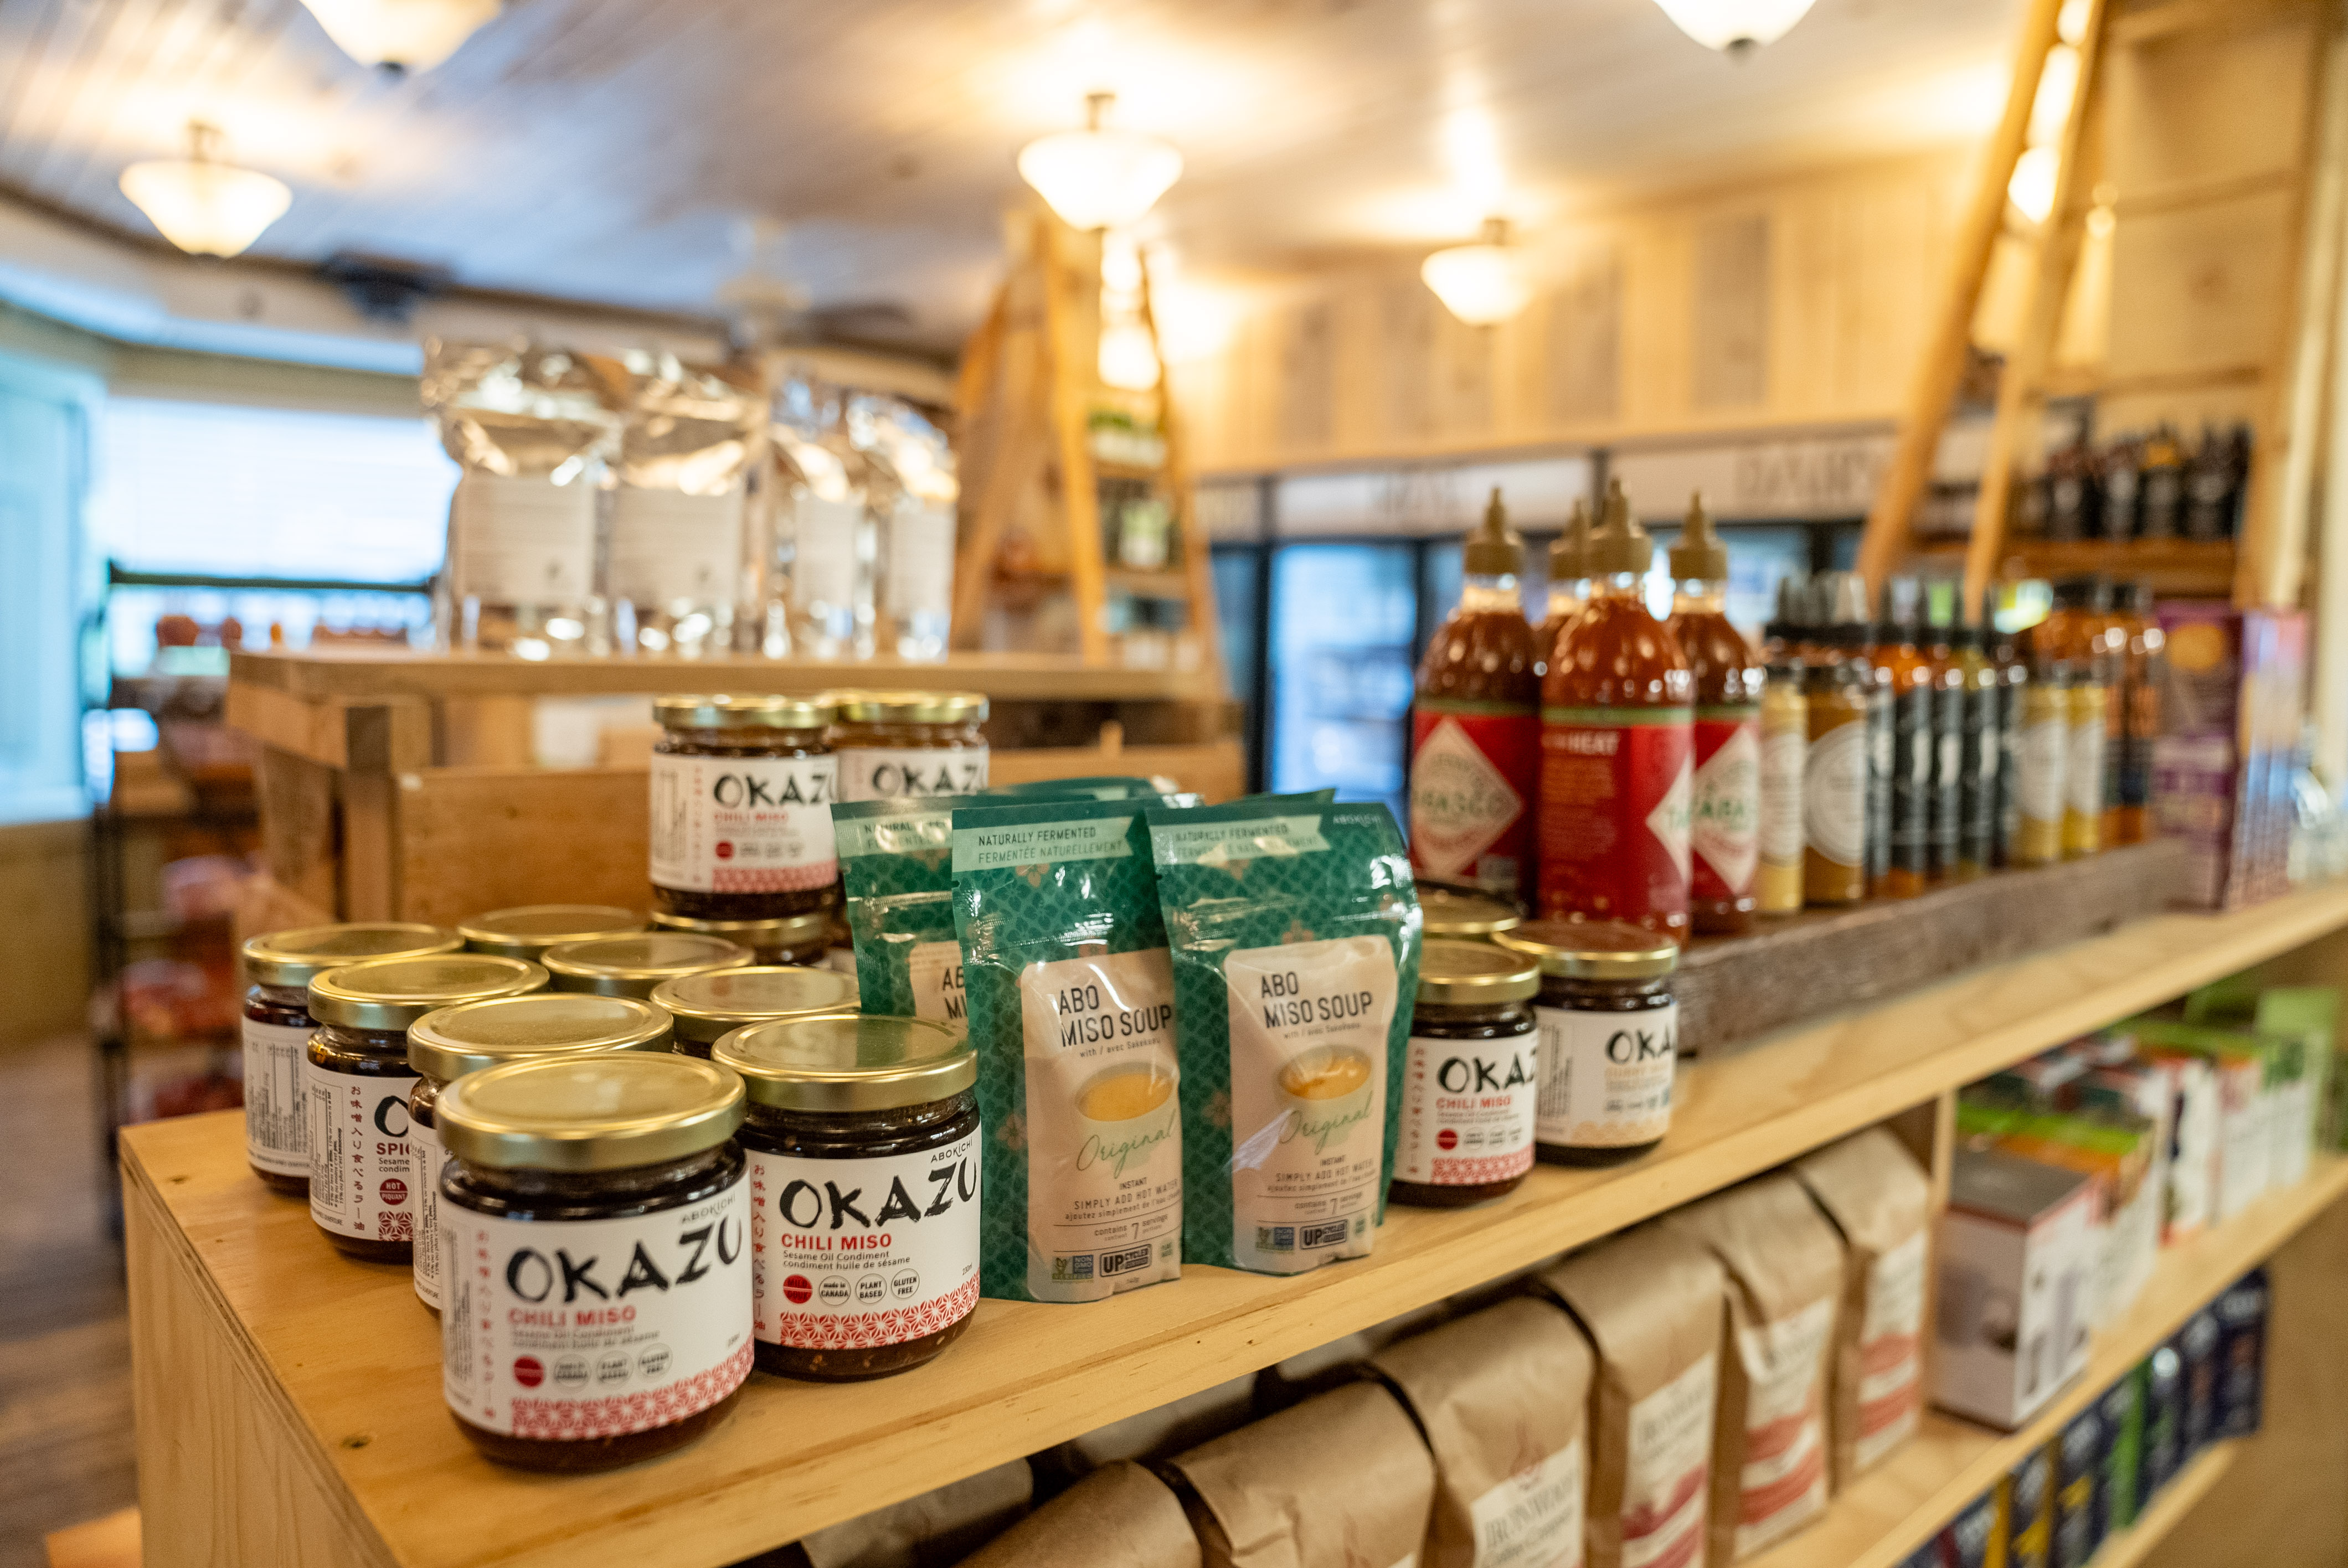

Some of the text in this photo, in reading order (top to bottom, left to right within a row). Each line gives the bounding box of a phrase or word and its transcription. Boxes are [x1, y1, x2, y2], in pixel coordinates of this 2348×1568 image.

[979, 826, 1096, 846] NATURALLY FERMENTED
[979, 840, 1121, 863] FERMENTÉE NATURELLEMENT
[1261, 971, 1298, 998] ABO
[1059, 985, 1100, 1015] ABO
[1263, 991, 1372, 1028] MISO SOUP
[1062, 1004, 1172, 1047] MISO SOUP
[1080, 1048, 1096, 1058] with
[931, 1136, 972, 1163] ABOKICHI
[1077, 1109, 1176, 1179] Original
[779, 1157, 976, 1230] OKAZU
[1119, 1177, 1148, 1190] INSTANT
[382, 1192, 406, 1200] PIQUANT
[1074, 1198, 1110, 1210] SIMPLY
[1114, 1193, 1132, 1205] ADD
[1137, 1188, 1152, 1200] HOT
[682, 1192, 736, 1224] ABOKICHI
[1065, 1212, 1095, 1221] ajoutez
[1098, 1204, 1140, 1218] simplement
[1330, 1198, 1337, 1215] 7
[1094, 1214, 1168, 1240] contains 7 servings
[781, 1232, 892, 1250] CHILI MISO
[1303, 1229, 1324, 1246] UP
[506, 1214, 743, 1304] OKAZU
[783, 1256, 910, 1270] condiment huile de sésame
[784, 1250, 890, 1261] Sesame Oil Condiment
[1103, 1254, 1124, 1273] UP
[860, 1281, 882, 1289] PLANT
[894, 1276, 917, 1287] GLUTEN
[898, 1287, 914, 1295] FREE
[507, 1305, 637, 1327] CHILI MISO
